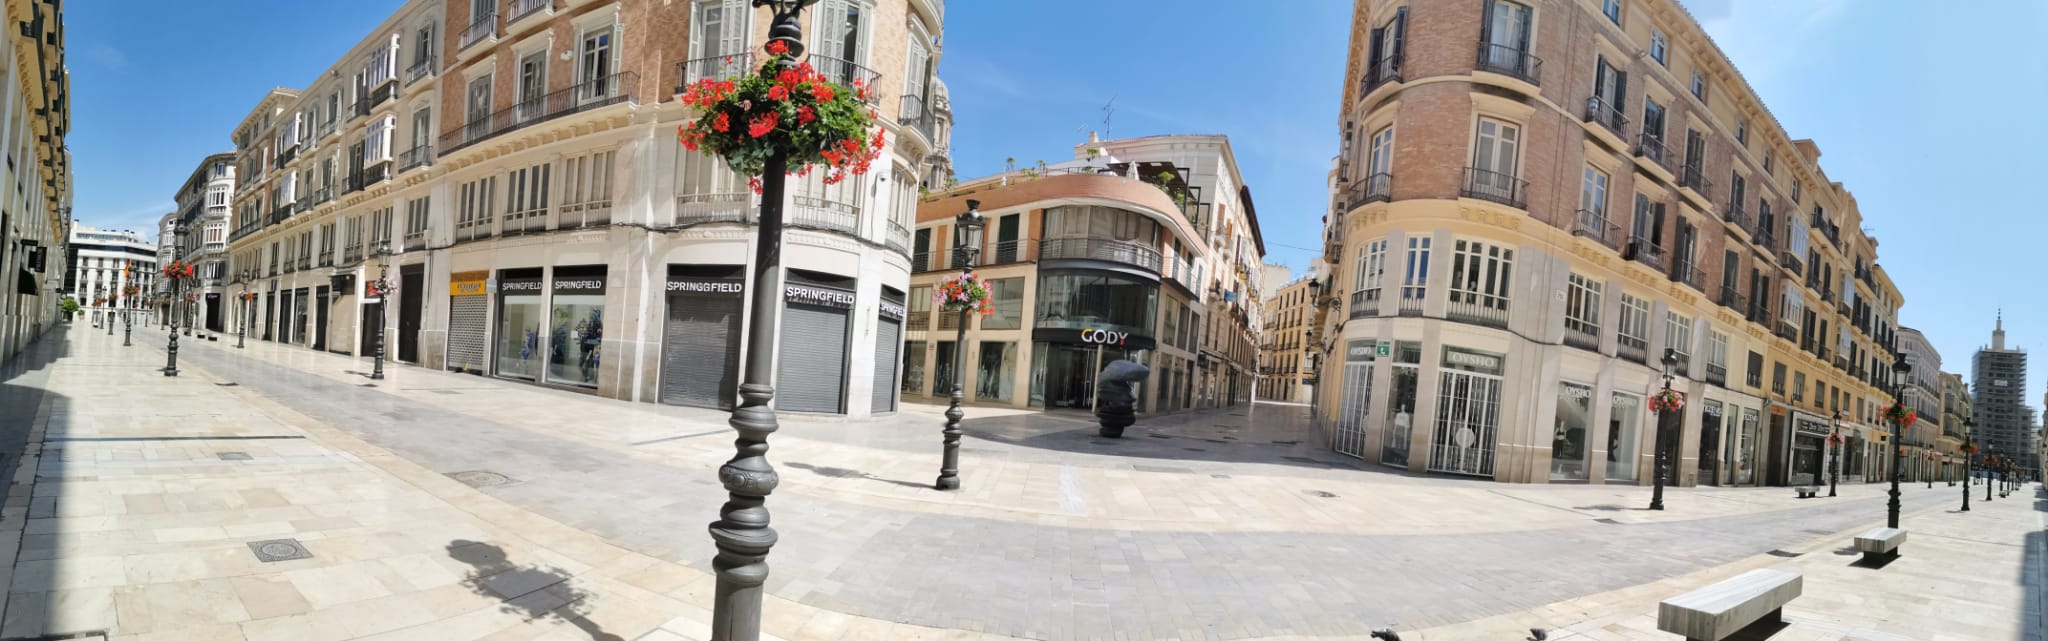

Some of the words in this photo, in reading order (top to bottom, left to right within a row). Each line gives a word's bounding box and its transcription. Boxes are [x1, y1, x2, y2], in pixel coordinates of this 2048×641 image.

[502, 282, 543, 291] SPRINGFIELD
[554, 280, 602, 290] SPRINGFIELD
[786, 286, 855, 304] SPRINGFIELD
[1081, 328, 1129, 346] GODY
[1452, 353, 1495, 367] OYSHO
